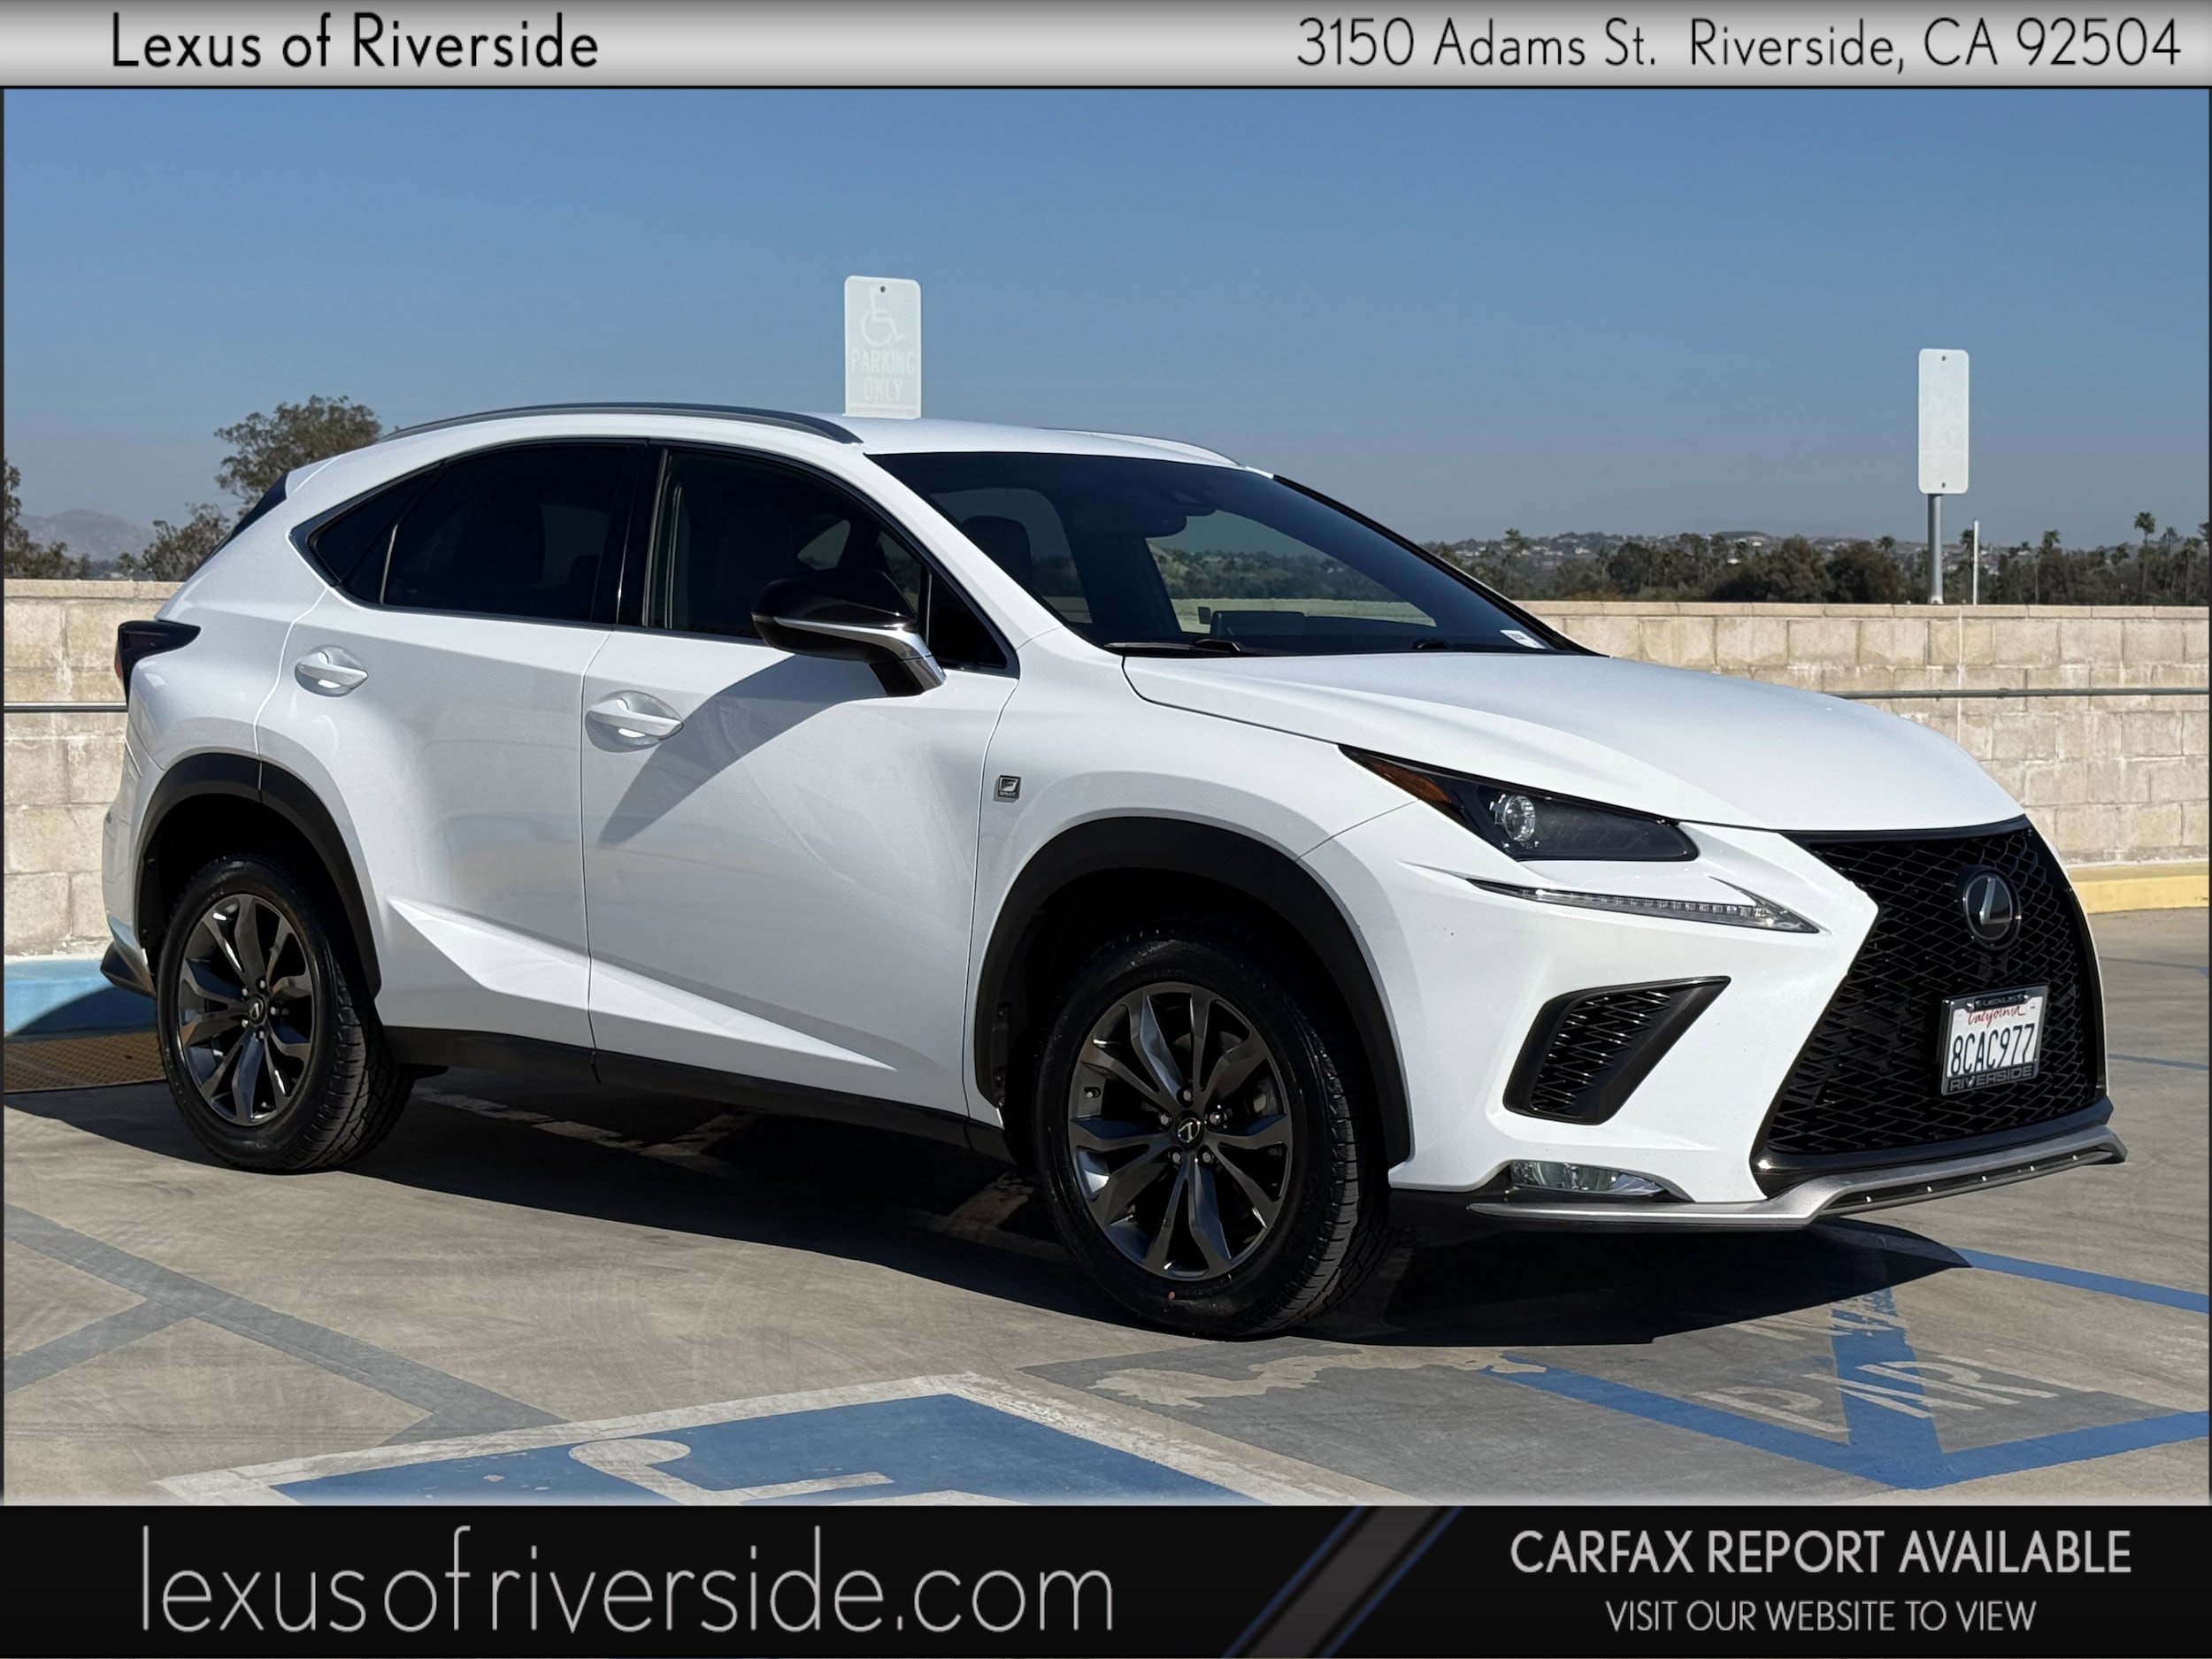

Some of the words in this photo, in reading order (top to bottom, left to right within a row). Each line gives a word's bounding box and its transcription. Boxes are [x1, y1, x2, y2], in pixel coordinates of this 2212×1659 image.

[849, 349, 916, 376] PARKING
[863, 377, 903, 402] ONLY
[1950, 1023, 2035, 1076] 8CAC977
[1949, 1064, 2033, 1092] RIVERSIDE
